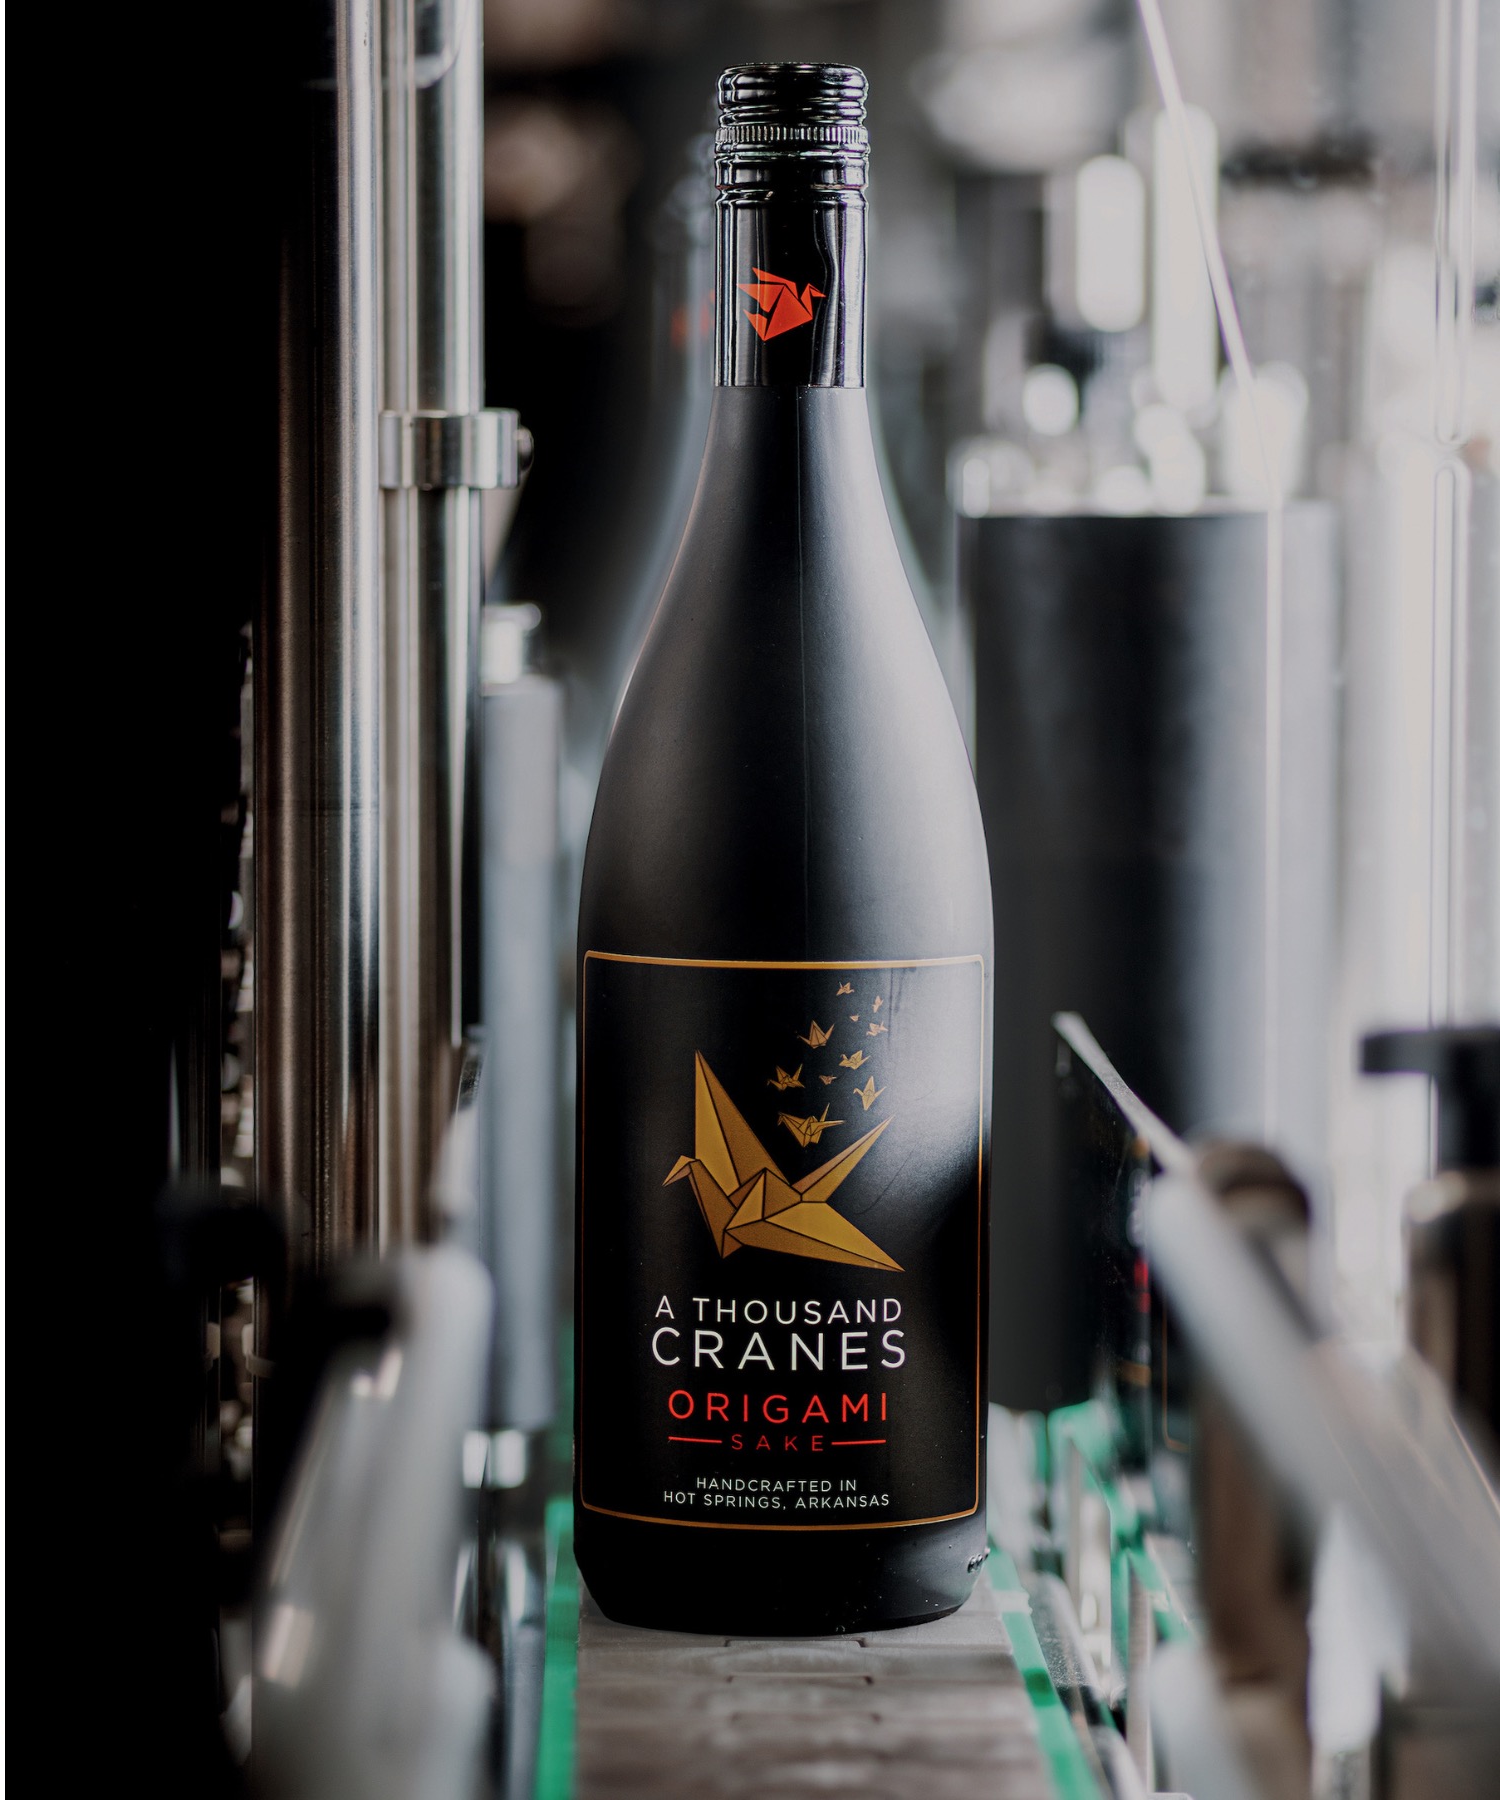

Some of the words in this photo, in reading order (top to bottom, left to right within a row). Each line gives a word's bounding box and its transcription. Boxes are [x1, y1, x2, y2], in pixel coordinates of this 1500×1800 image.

[654, 1294, 675, 1320] A
[692, 1297, 902, 1325] THOUSAND
[651, 1326, 906, 1371] CRANES
[668, 1389, 887, 1424] ORIGAMI
[731, 1433, 824, 1452] SAKE
[696, 1476, 832, 1493] HANDCRAFTED
[840, 1479, 857, 1492] IN
[664, 1490, 696, 1505] HOT
[703, 1494, 786, 1510] SPRINGS,
[795, 1490, 890, 1509] ARKANSAS
